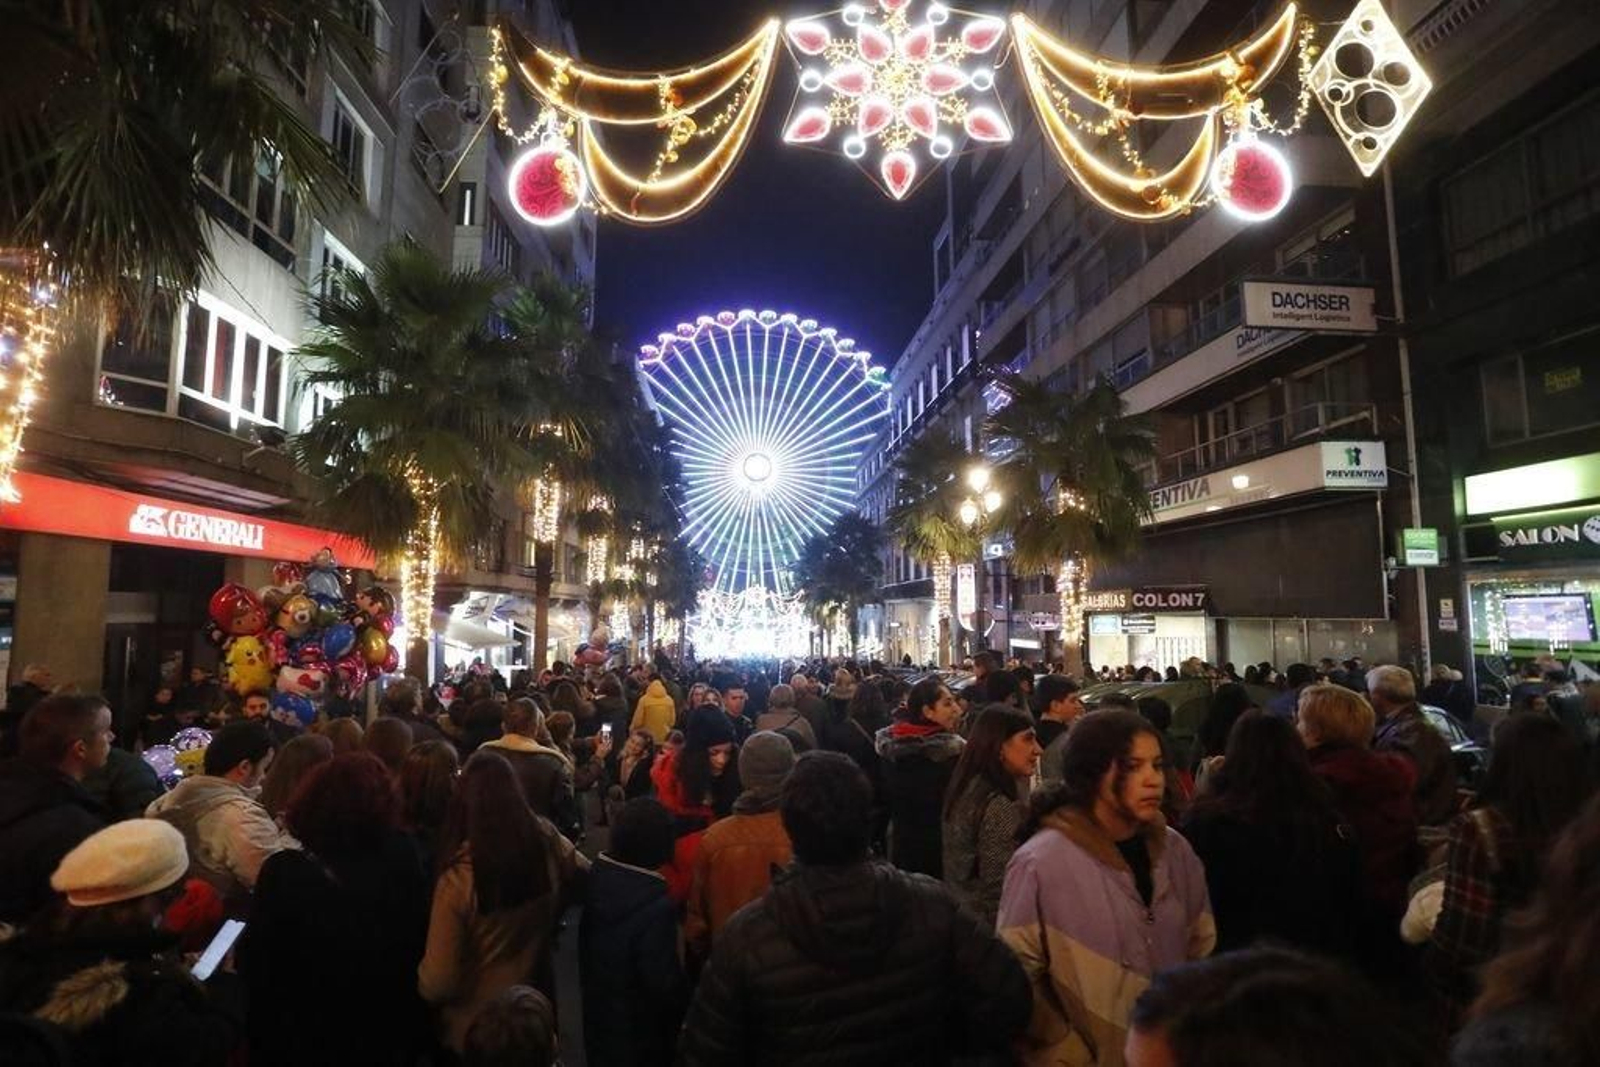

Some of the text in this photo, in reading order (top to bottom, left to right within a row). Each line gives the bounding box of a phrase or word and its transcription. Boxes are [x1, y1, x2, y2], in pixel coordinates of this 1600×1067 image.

[1272, 291, 1350, 311] DACHSER
[1325, 469, 1385, 478] PREVENTIVA
[1151, 477, 1210, 510] ENTIVA
[168, 509, 265, 550] GENERALI
[1499, 523, 1580, 547] SALON
